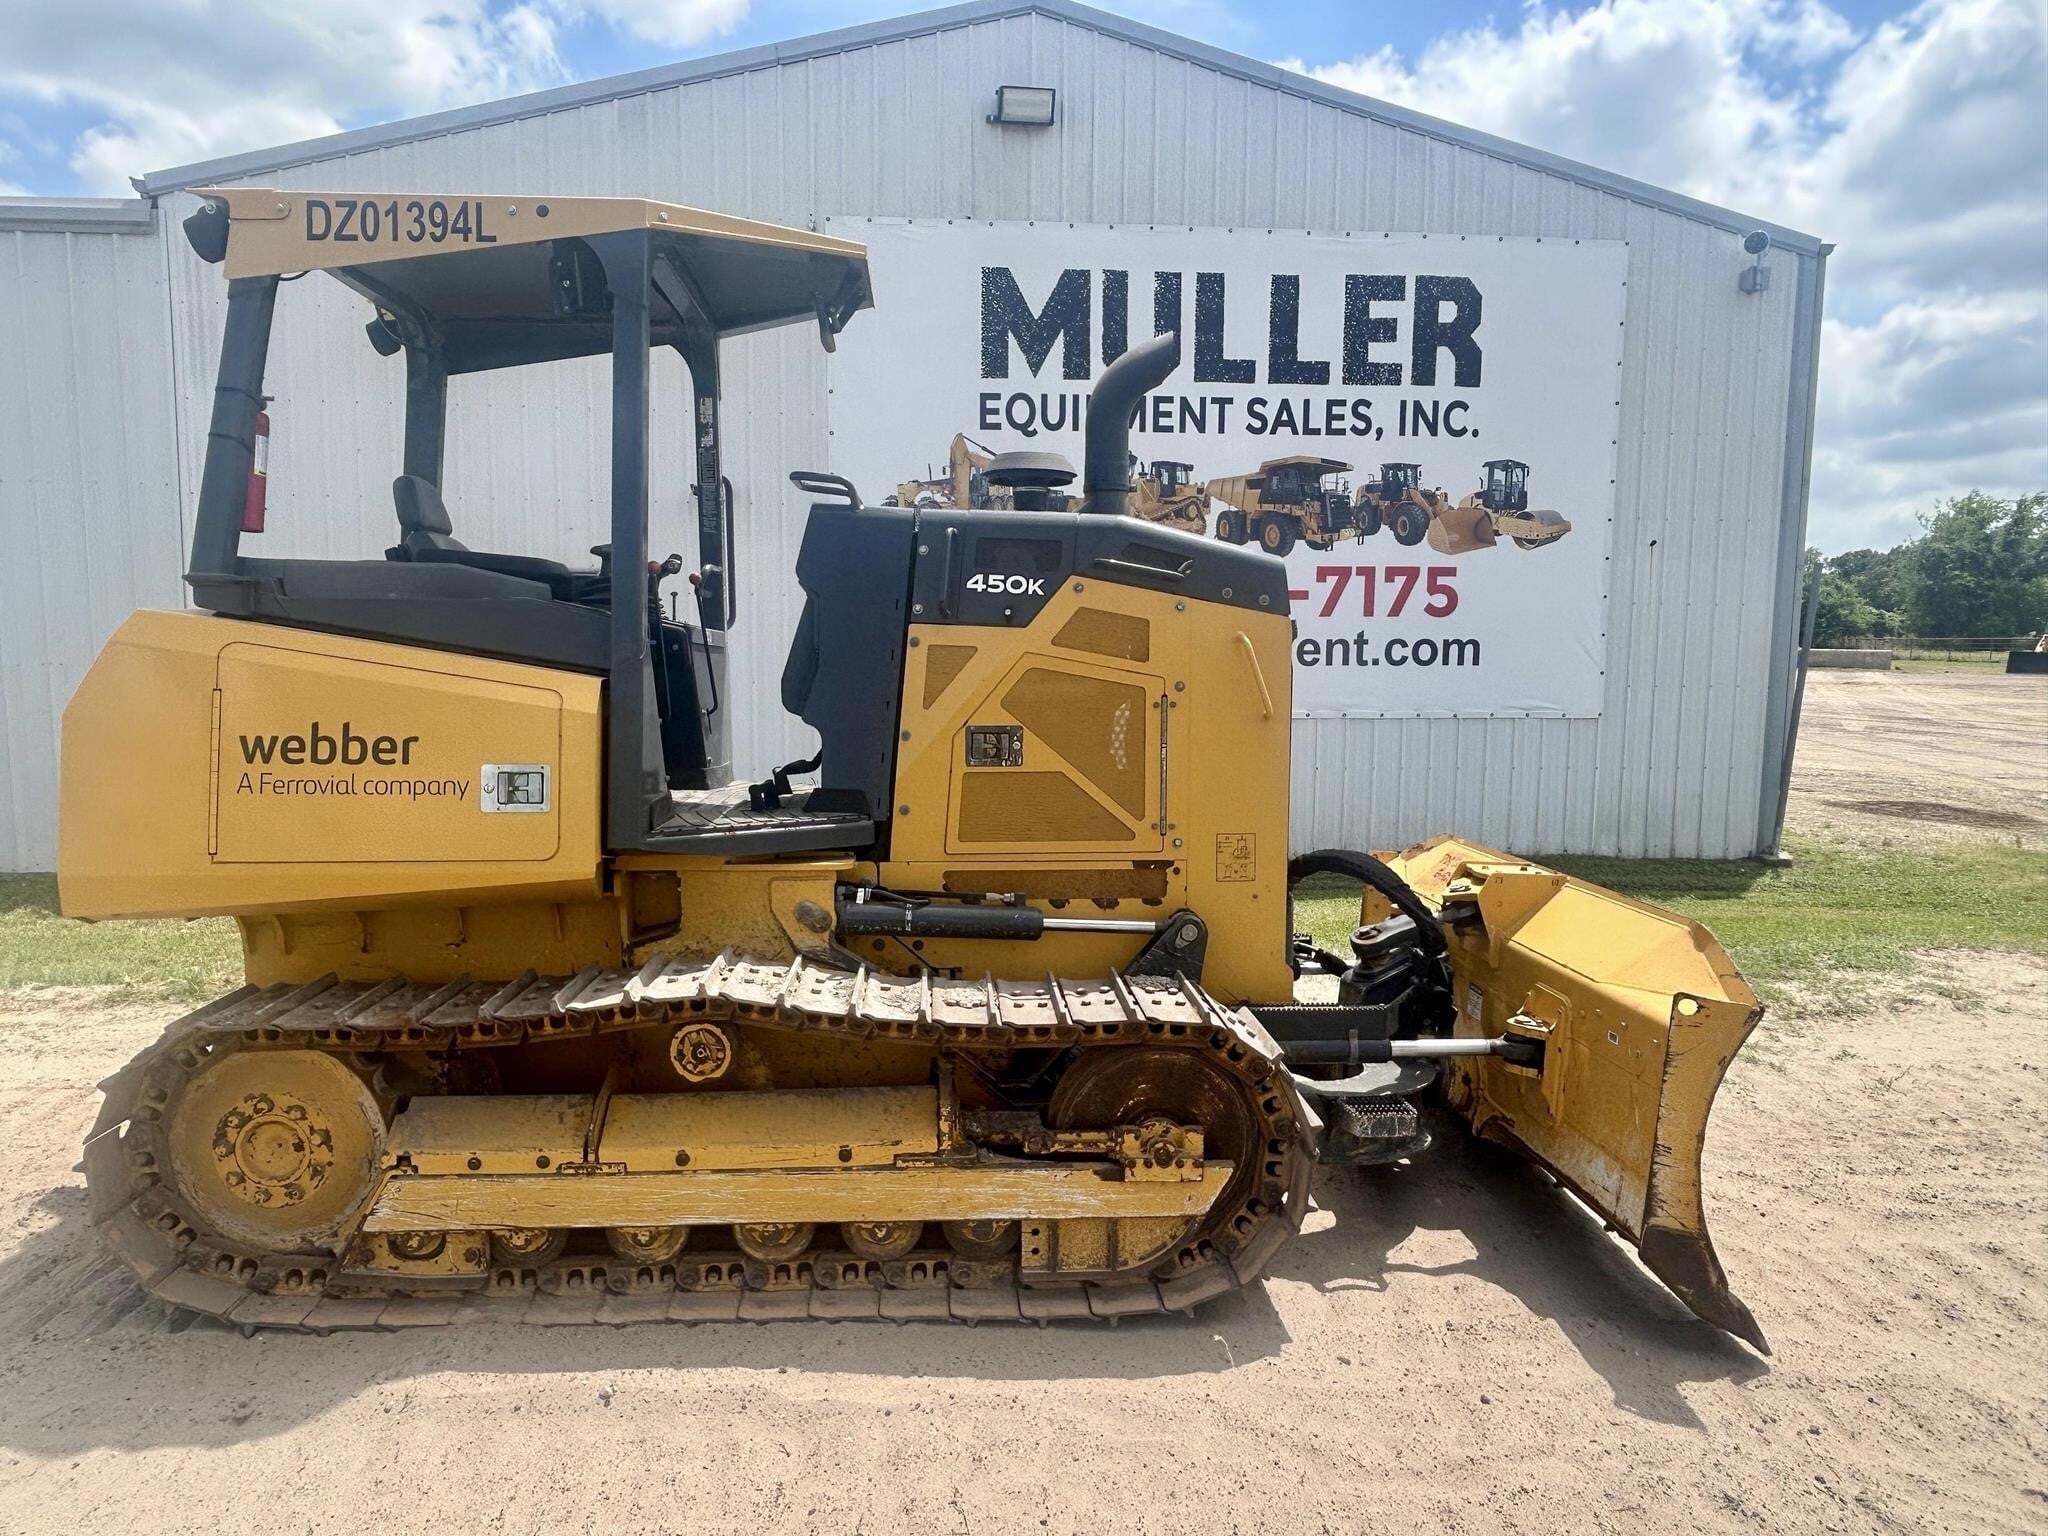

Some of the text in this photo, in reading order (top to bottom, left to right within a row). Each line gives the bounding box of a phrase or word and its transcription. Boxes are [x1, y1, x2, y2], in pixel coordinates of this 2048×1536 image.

[306, 199, 497, 243] DZ01394L
[980, 266, 1484, 388] MULLER
[979, 392, 1480, 442] EQUIENT SALES, INC.
[966, 573, 1046, 596] 450K
[238, 721, 420, 766] webber
[236, 772, 470, 801] A Ferrovial company
